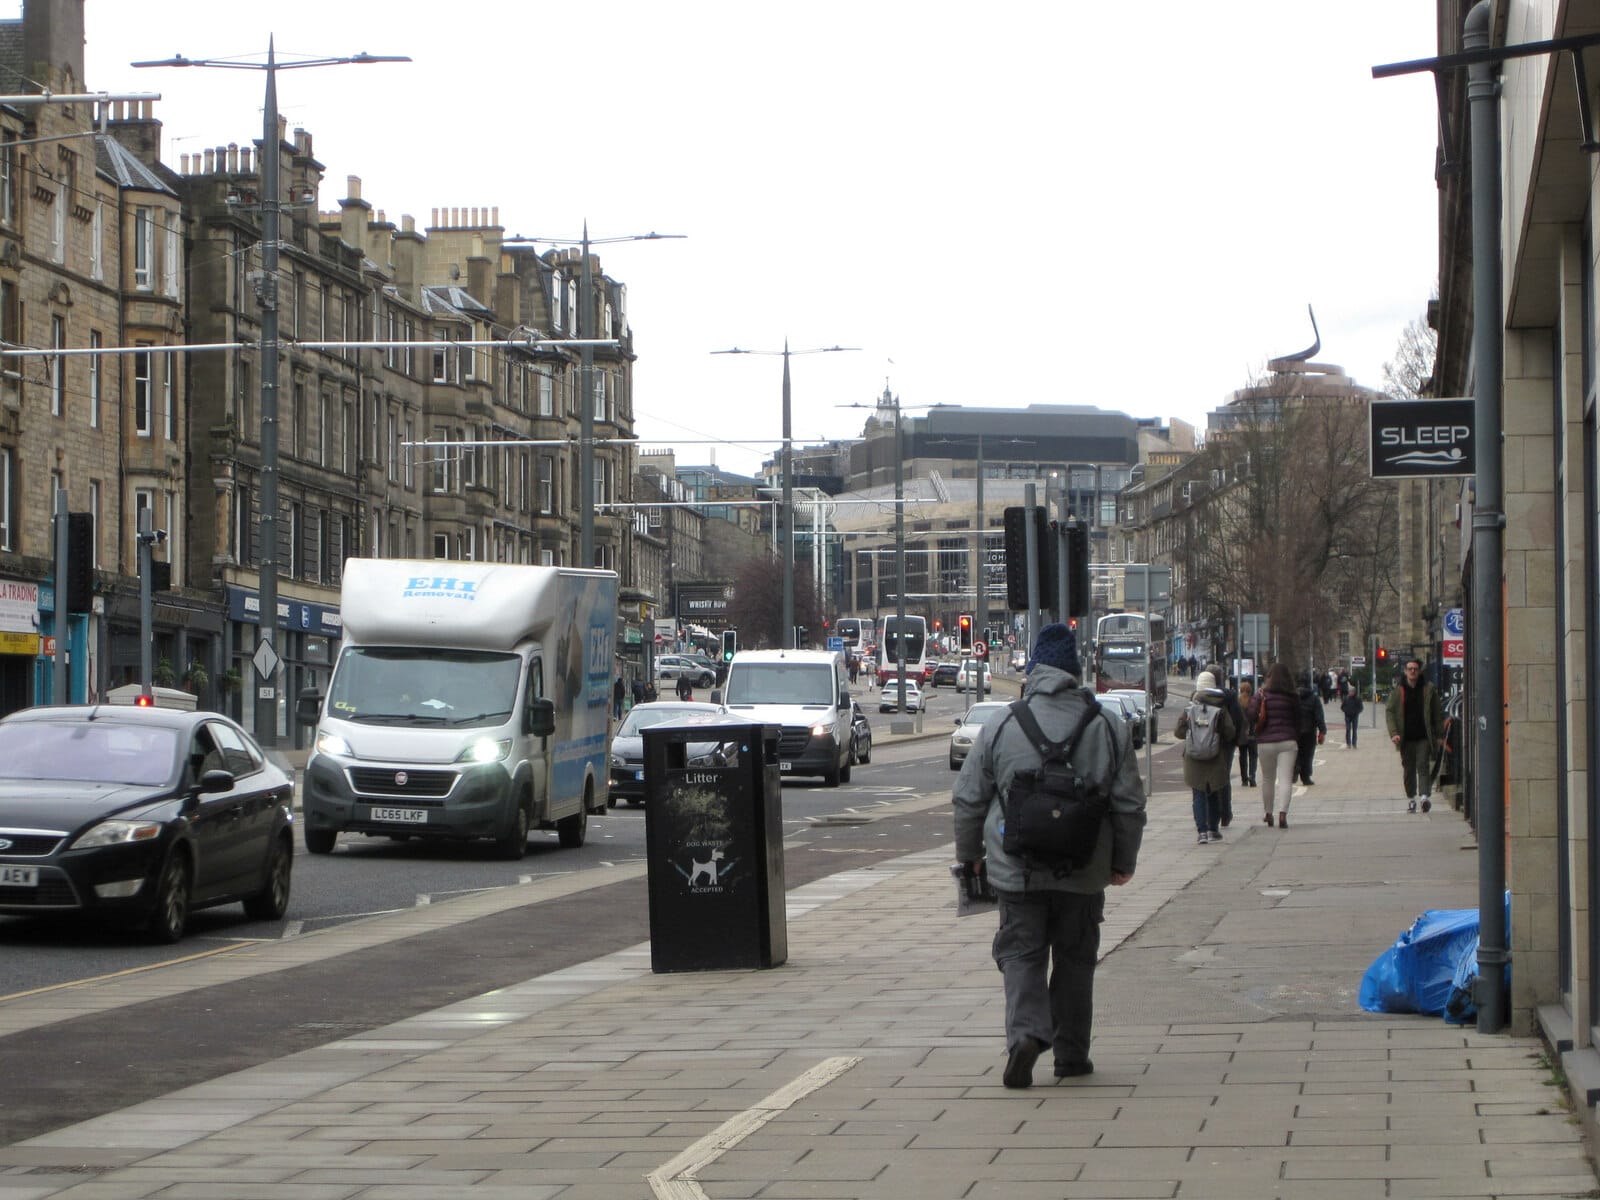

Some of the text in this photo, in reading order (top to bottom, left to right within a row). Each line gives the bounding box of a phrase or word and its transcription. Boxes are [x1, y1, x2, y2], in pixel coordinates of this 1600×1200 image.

[1381, 426, 1470, 445] SLEEP
[8, 584, 37, 602] TRADING
[403, 590, 475, 601] Removals
[1136, 646, 1142, 654] 7
[685, 772, 719, 784] Litter
[374, 809, 424, 821] LC65 LKF
